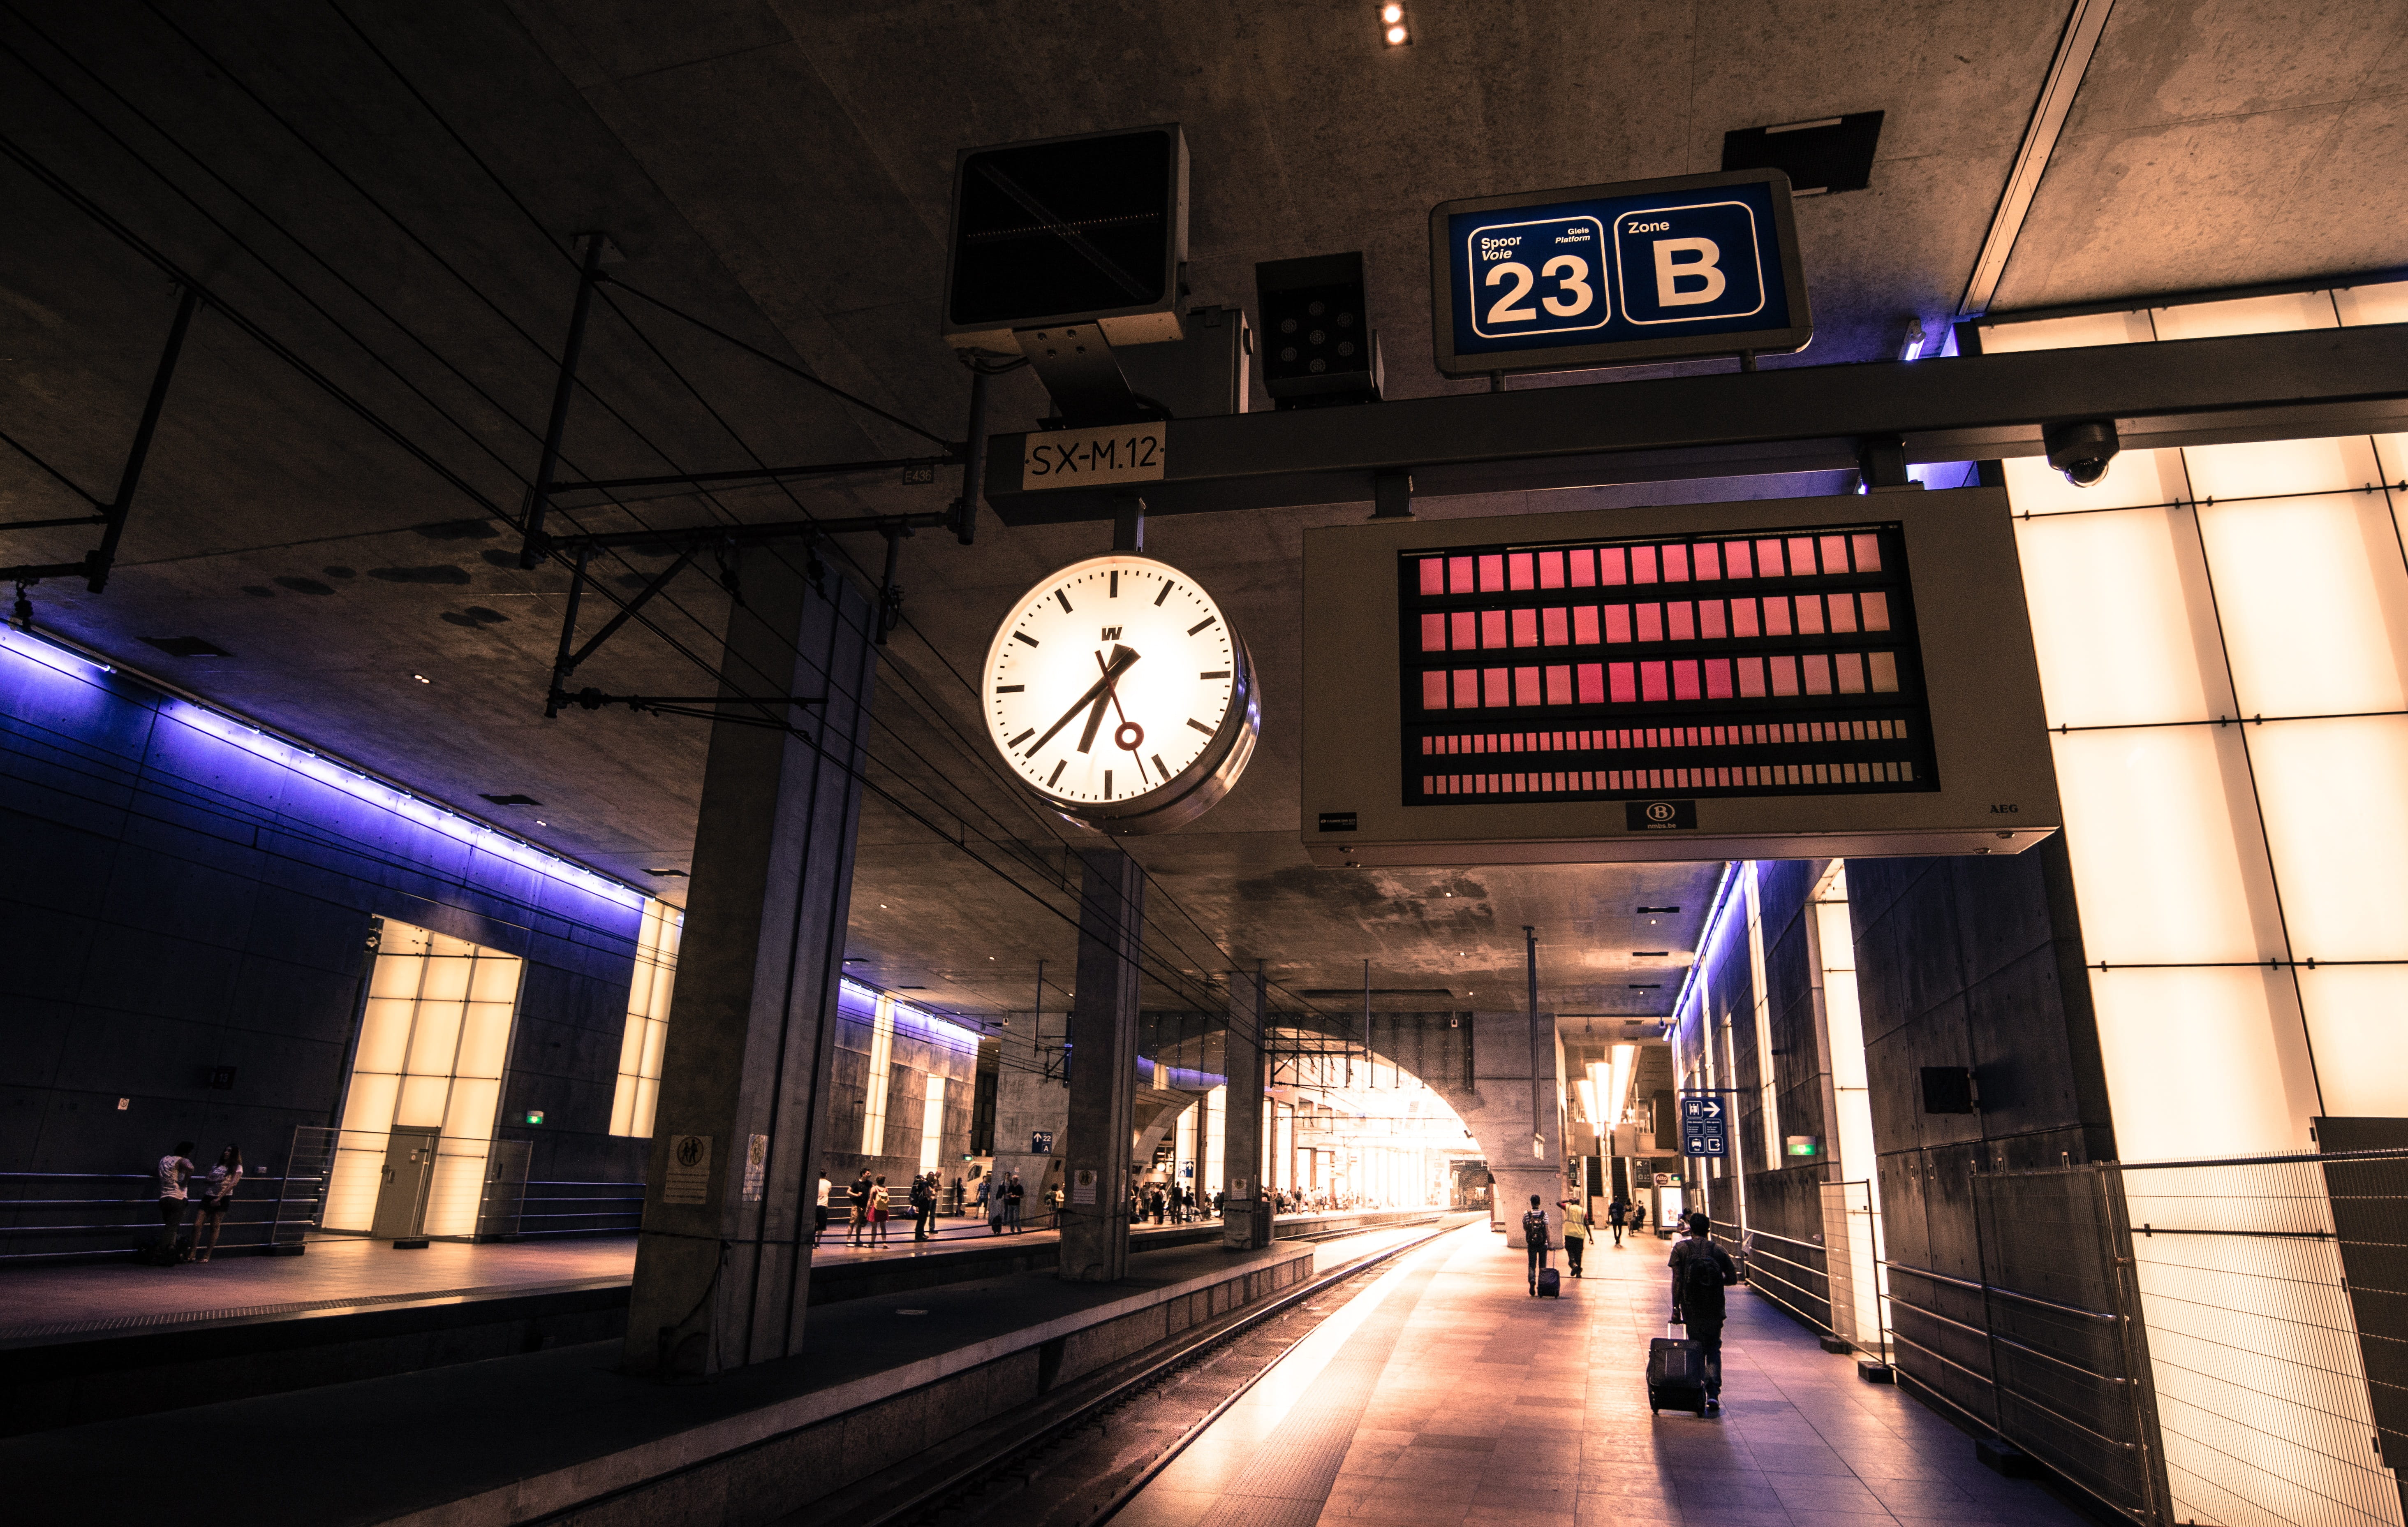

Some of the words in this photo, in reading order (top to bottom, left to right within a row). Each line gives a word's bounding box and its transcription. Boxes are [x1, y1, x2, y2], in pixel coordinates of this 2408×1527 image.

[1567, 227, 1589, 235] Gleis
[1628, 221, 1670, 234] Zone
[1481, 235, 1522, 250] Spoor
[1555, 233, 1591, 243] Platform
[1481, 248, 1513, 261] Voie
[1652, 236, 1726, 307] B
[1485, 255, 1594, 324] 23
[1032, 436, 1158, 475] SX-M.12
[905, 470, 931, 482] E436
[1101, 627, 1122, 641] W
[1990, 804, 2019, 814] AEG
